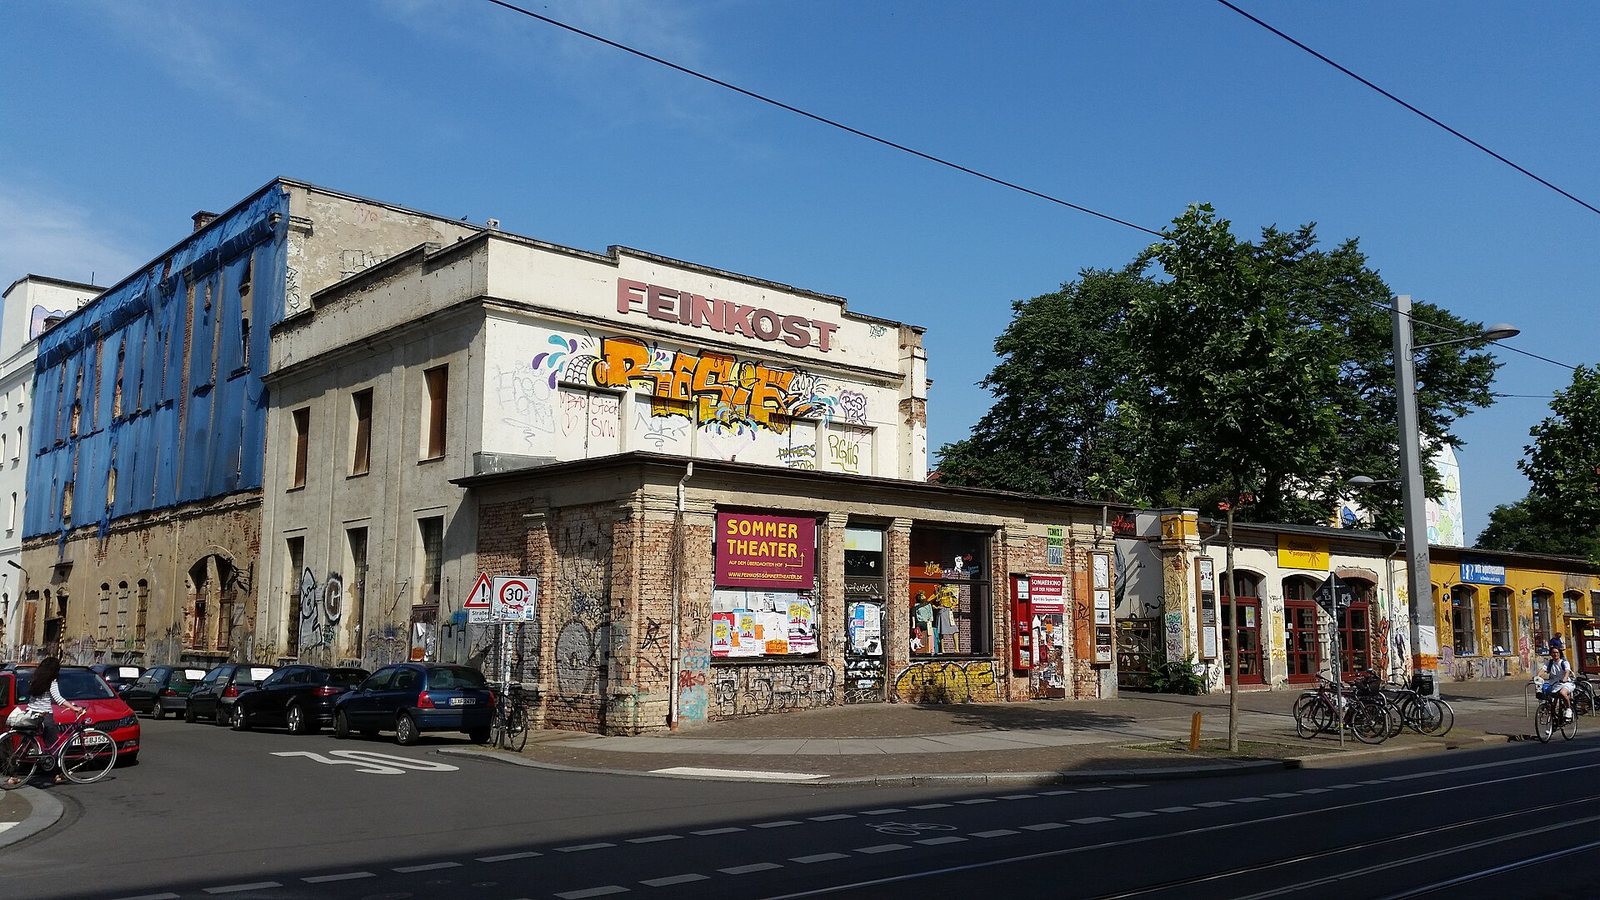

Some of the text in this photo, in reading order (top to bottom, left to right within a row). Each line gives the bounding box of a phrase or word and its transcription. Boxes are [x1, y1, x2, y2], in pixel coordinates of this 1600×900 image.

[616, 277, 840, 353] FEINKOST
[726, 519, 798, 539] SOMMER
[726, 539, 798, 559] THEATER
[505, 588, 523, 602] 30
